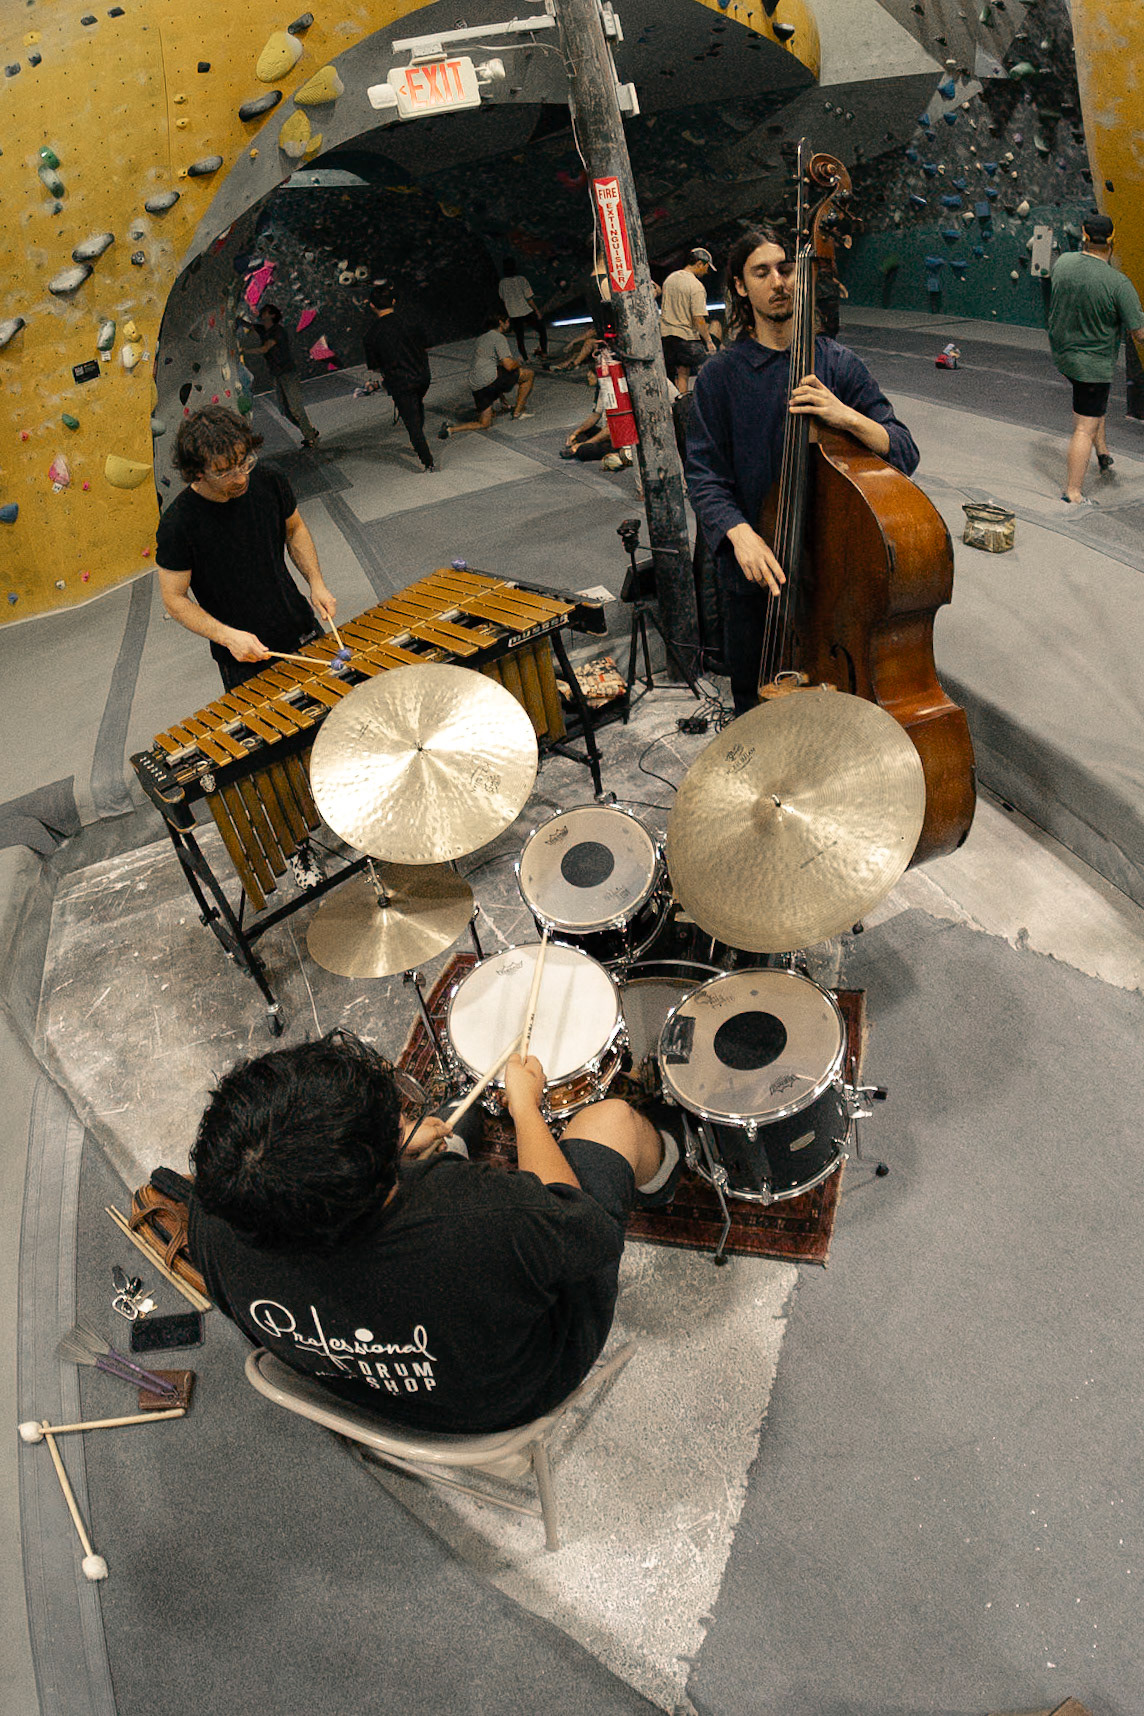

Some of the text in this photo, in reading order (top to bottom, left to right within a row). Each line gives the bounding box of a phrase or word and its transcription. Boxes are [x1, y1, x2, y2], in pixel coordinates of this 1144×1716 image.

[404, 61, 467, 108] EXIT
[598, 187, 617, 200] FIRE
[606, 203, 625, 283] EXTINGUISHER
[250, 1300, 438, 1372] Professional
[358, 1361, 434, 1378] DRUM
[366, 1376, 436, 1392] SHOP
